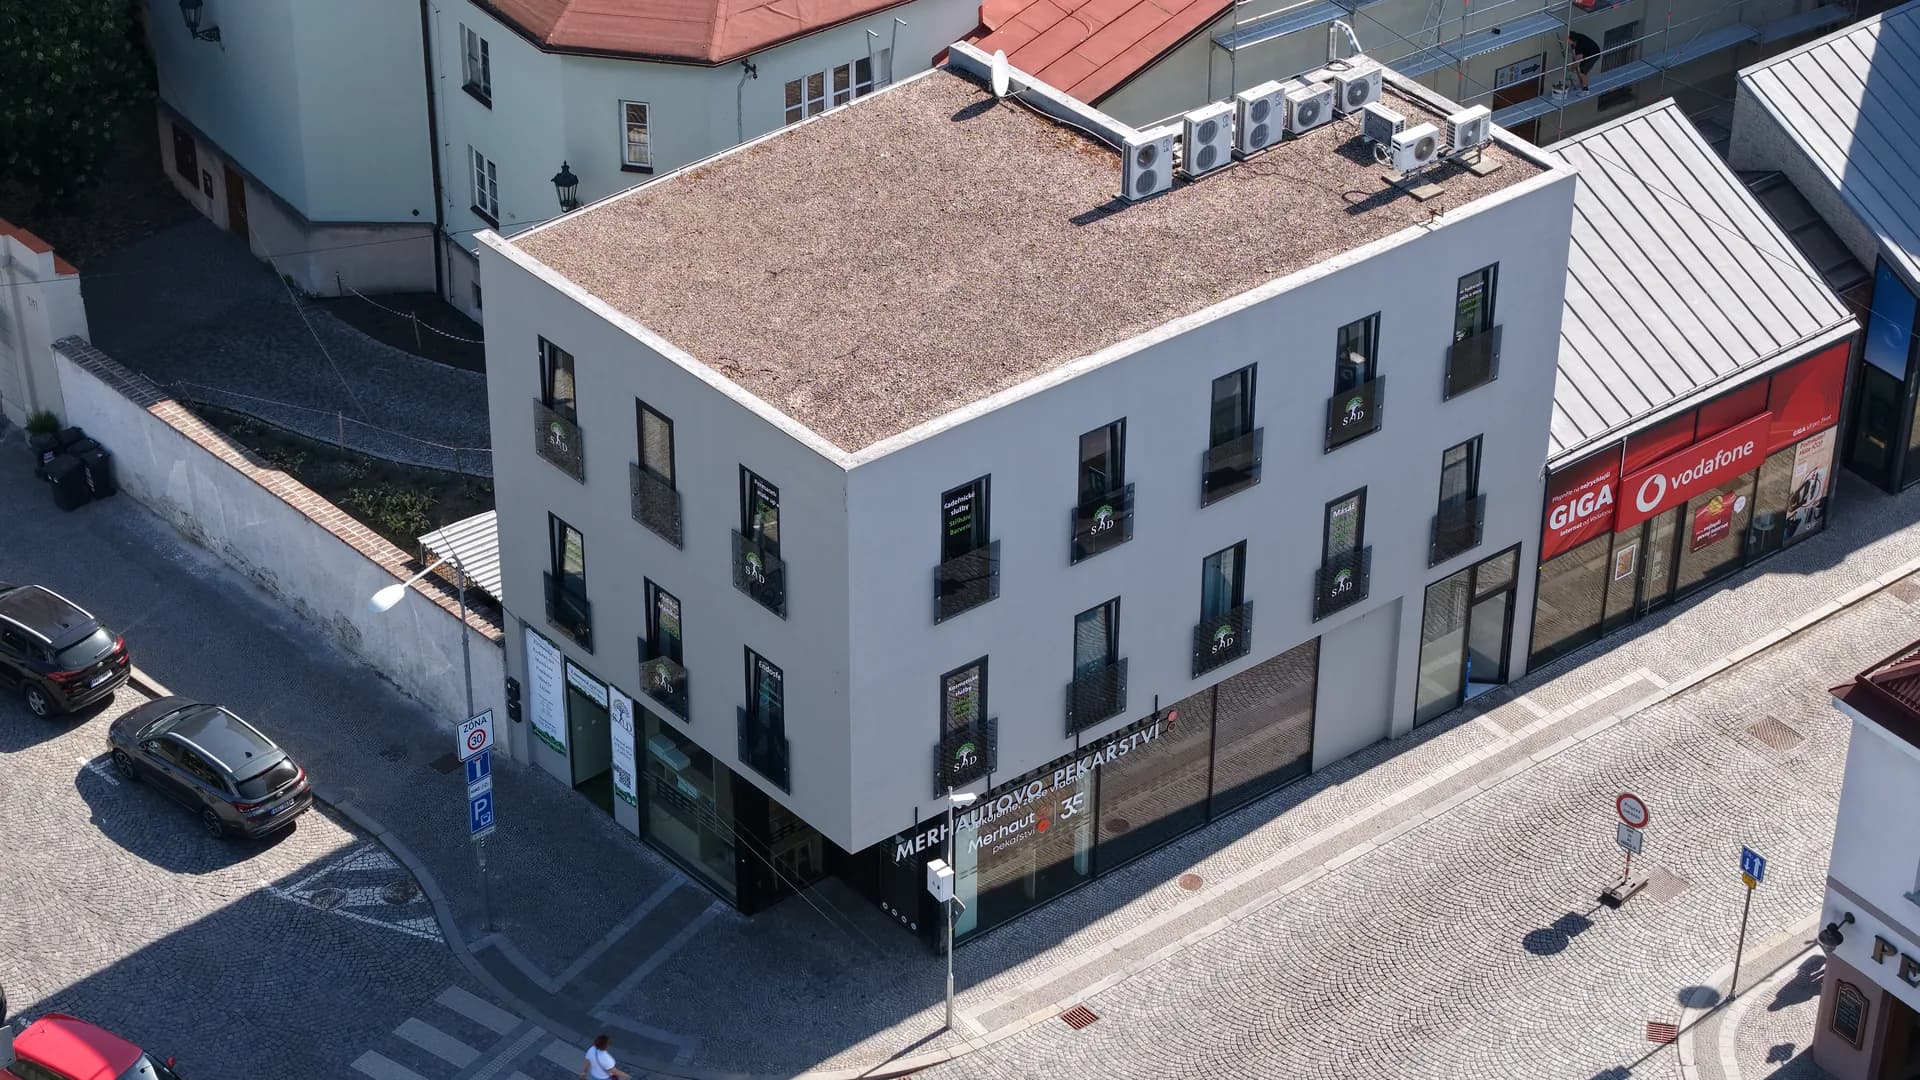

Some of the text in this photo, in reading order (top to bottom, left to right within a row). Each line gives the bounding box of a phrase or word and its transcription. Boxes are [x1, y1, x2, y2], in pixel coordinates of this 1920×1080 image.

[1342, 410, 1364, 426] SAD
[1671, 440, 1754, 489] vodafone
[1549, 484, 1614, 530] GIGA
[1090, 519, 1114, 536] SAD
[745, 565, 765, 584] SAD
[1331, 581, 1353, 598] SAD
[1211, 637, 1234, 654] SAD
[655, 675, 673, 694] SAD
[471, 733, 483, 746] 30
[953, 755, 977, 773] SAD
[895, 718, 1160, 862] MERHAUTOVO PEKAŘSTVÍ
[474, 798, 488, 821] P
[967, 791, 1085, 855] Merhaut 35
